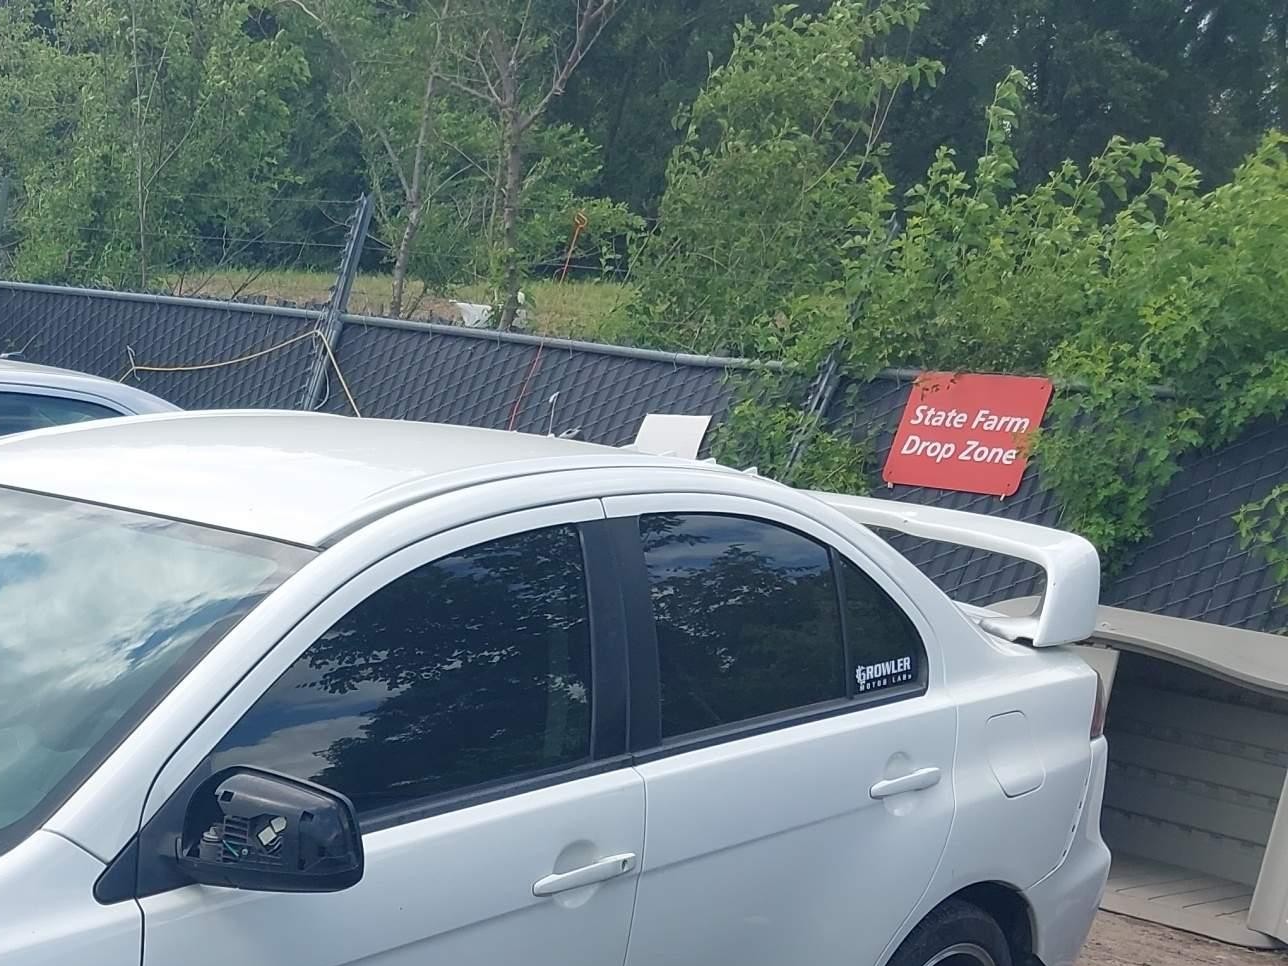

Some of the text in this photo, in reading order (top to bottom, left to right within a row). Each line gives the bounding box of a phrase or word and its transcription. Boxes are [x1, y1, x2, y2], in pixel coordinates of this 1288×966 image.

[910, 405, 1030, 433] State Farm
[901, 435, 1017, 465] Drop Zone
[855, 656, 911, 684] GROWLER
